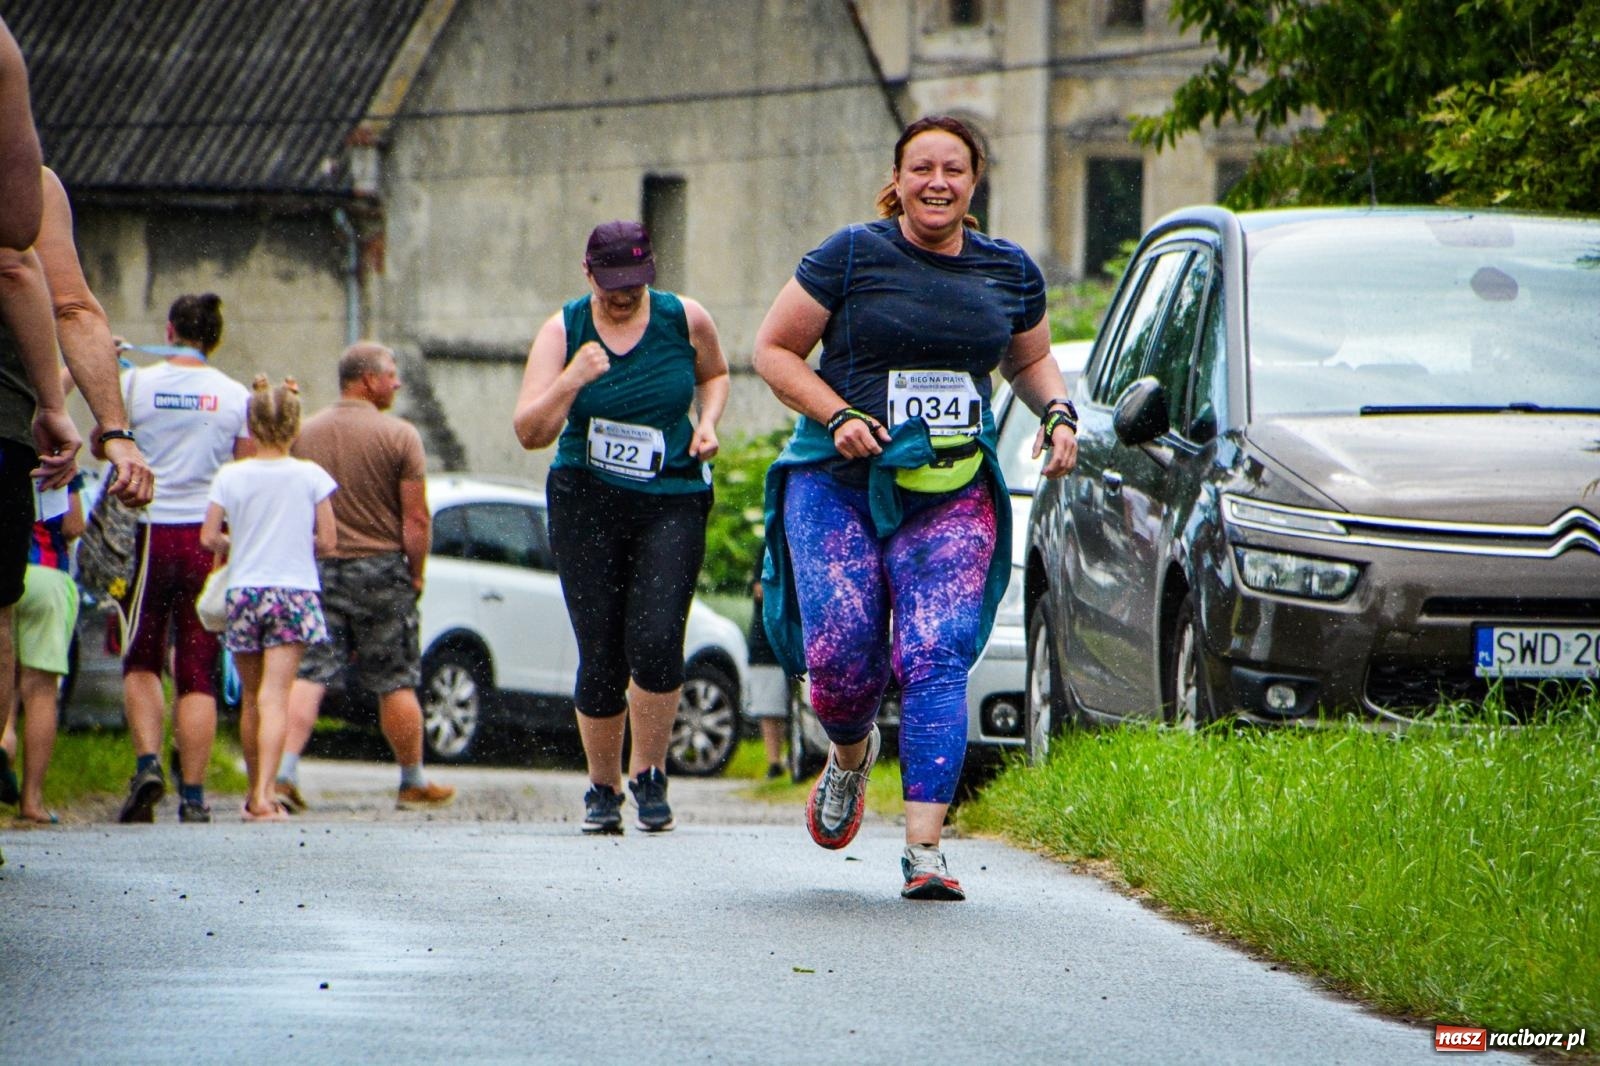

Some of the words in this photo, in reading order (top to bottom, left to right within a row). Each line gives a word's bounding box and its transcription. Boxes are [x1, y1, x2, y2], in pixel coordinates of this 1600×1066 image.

[905, 396, 961, 420] 034
[605, 440, 639, 464] 122
[1497, 631, 1561, 664] SWD
